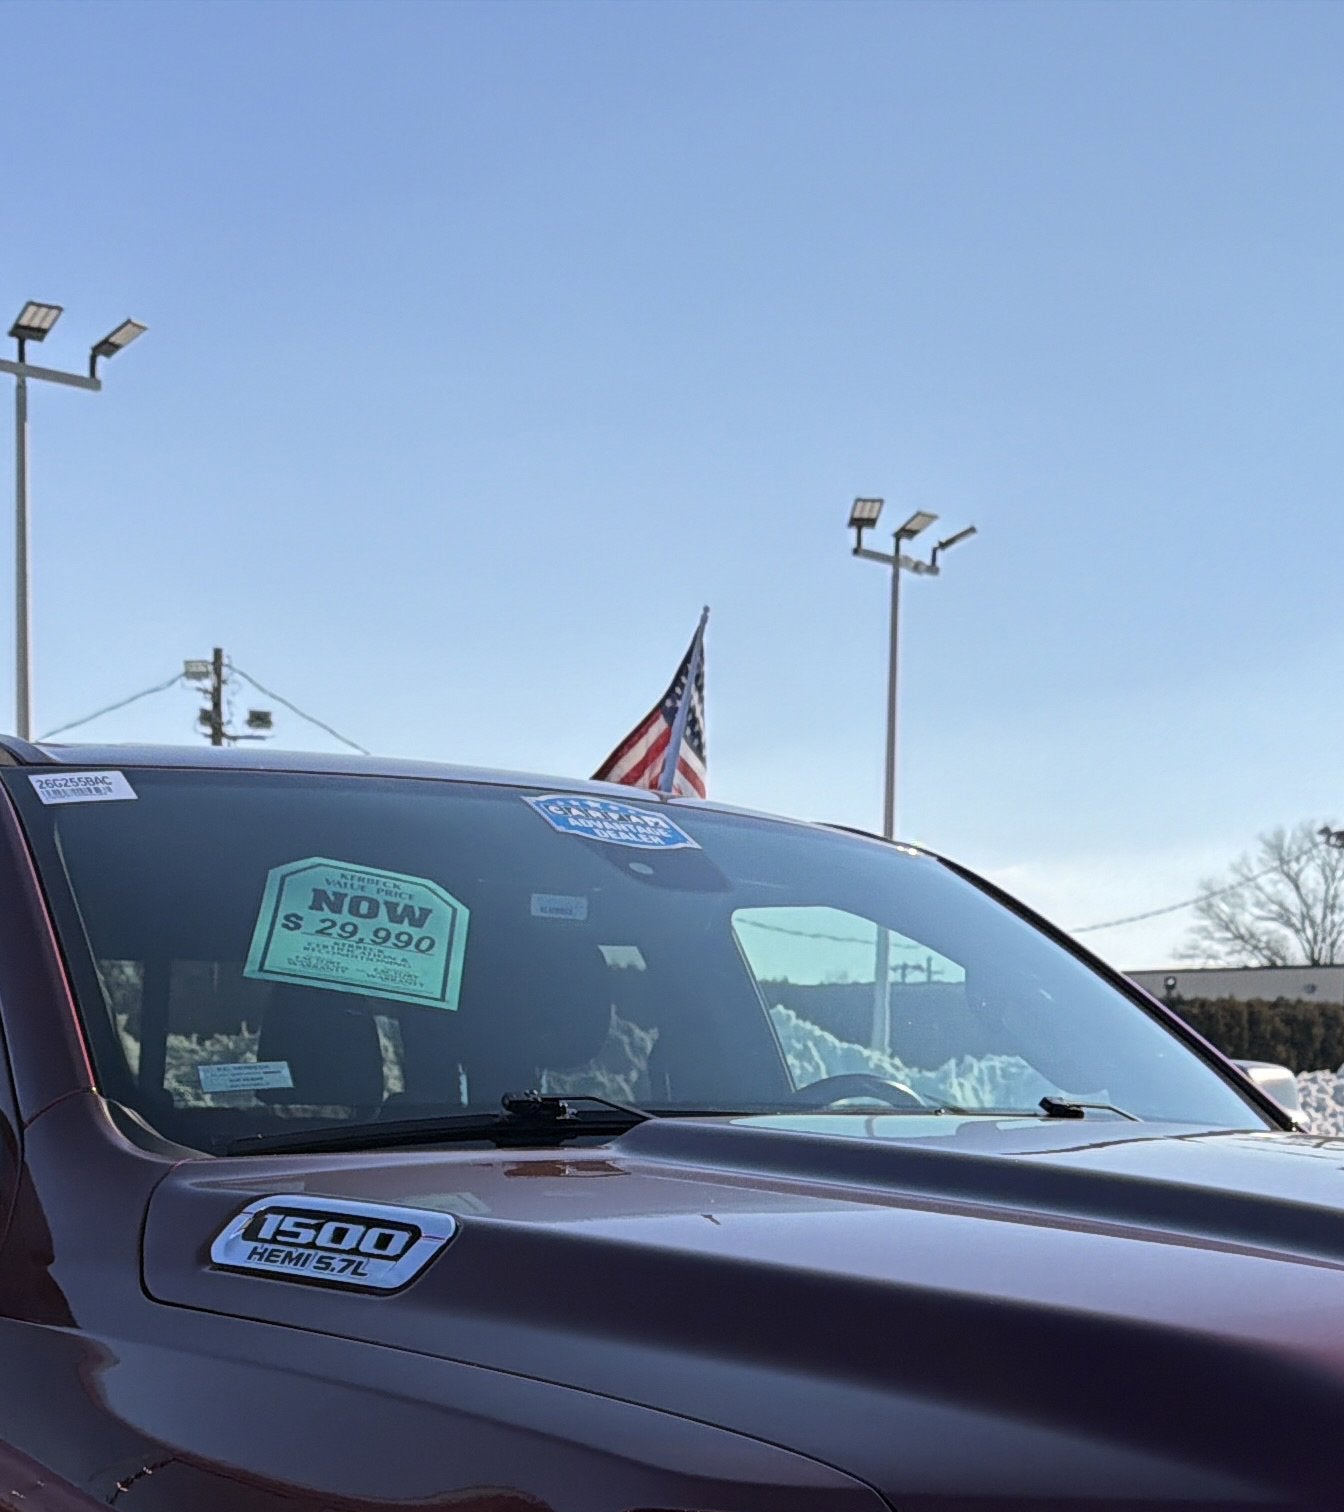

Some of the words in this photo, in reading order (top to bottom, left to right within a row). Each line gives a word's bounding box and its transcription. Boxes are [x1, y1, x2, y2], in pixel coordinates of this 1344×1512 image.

[567, 817, 674, 838] ADVANTAGE
[593, 828, 666, 847] DEALER
[324, 878, 370, 893] VALUE
[376, 887, 415, 901] PRICE
[308, 887, 433, 929] NOW
[314, 918, 436, 954] 29,990
[257, 1214, 413, 1256] 1500
[247, 1246, 312, 1268] HEMI
[313, 1255, 369, 1277] 5.7L
